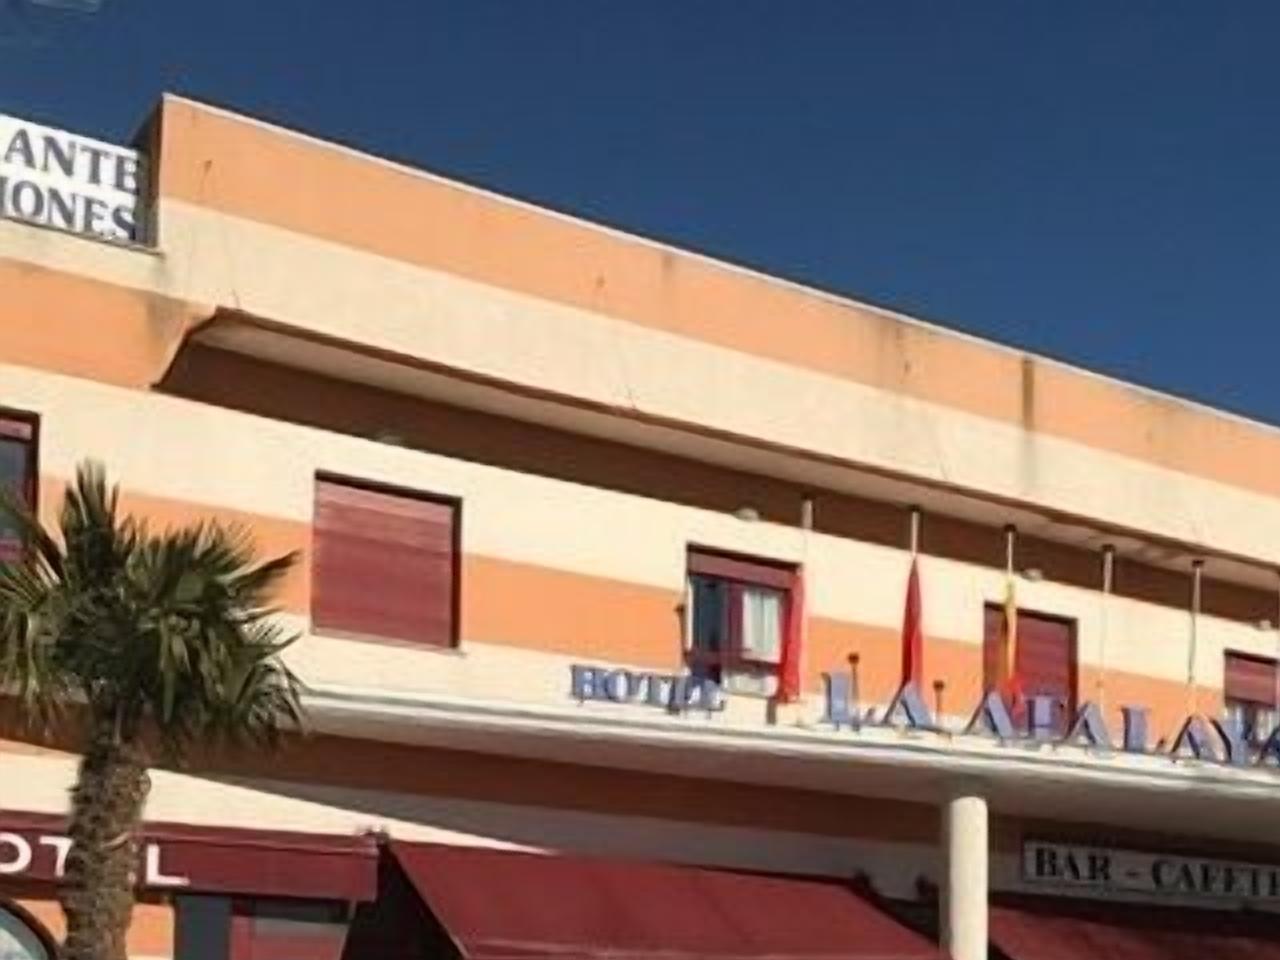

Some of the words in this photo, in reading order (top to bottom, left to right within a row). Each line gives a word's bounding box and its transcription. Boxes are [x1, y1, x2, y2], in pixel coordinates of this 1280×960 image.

[4, 127, 139, 196] ANTE
[0, 831, 191, 886] OTL
[1034, 847, 1112, 881] BAR
